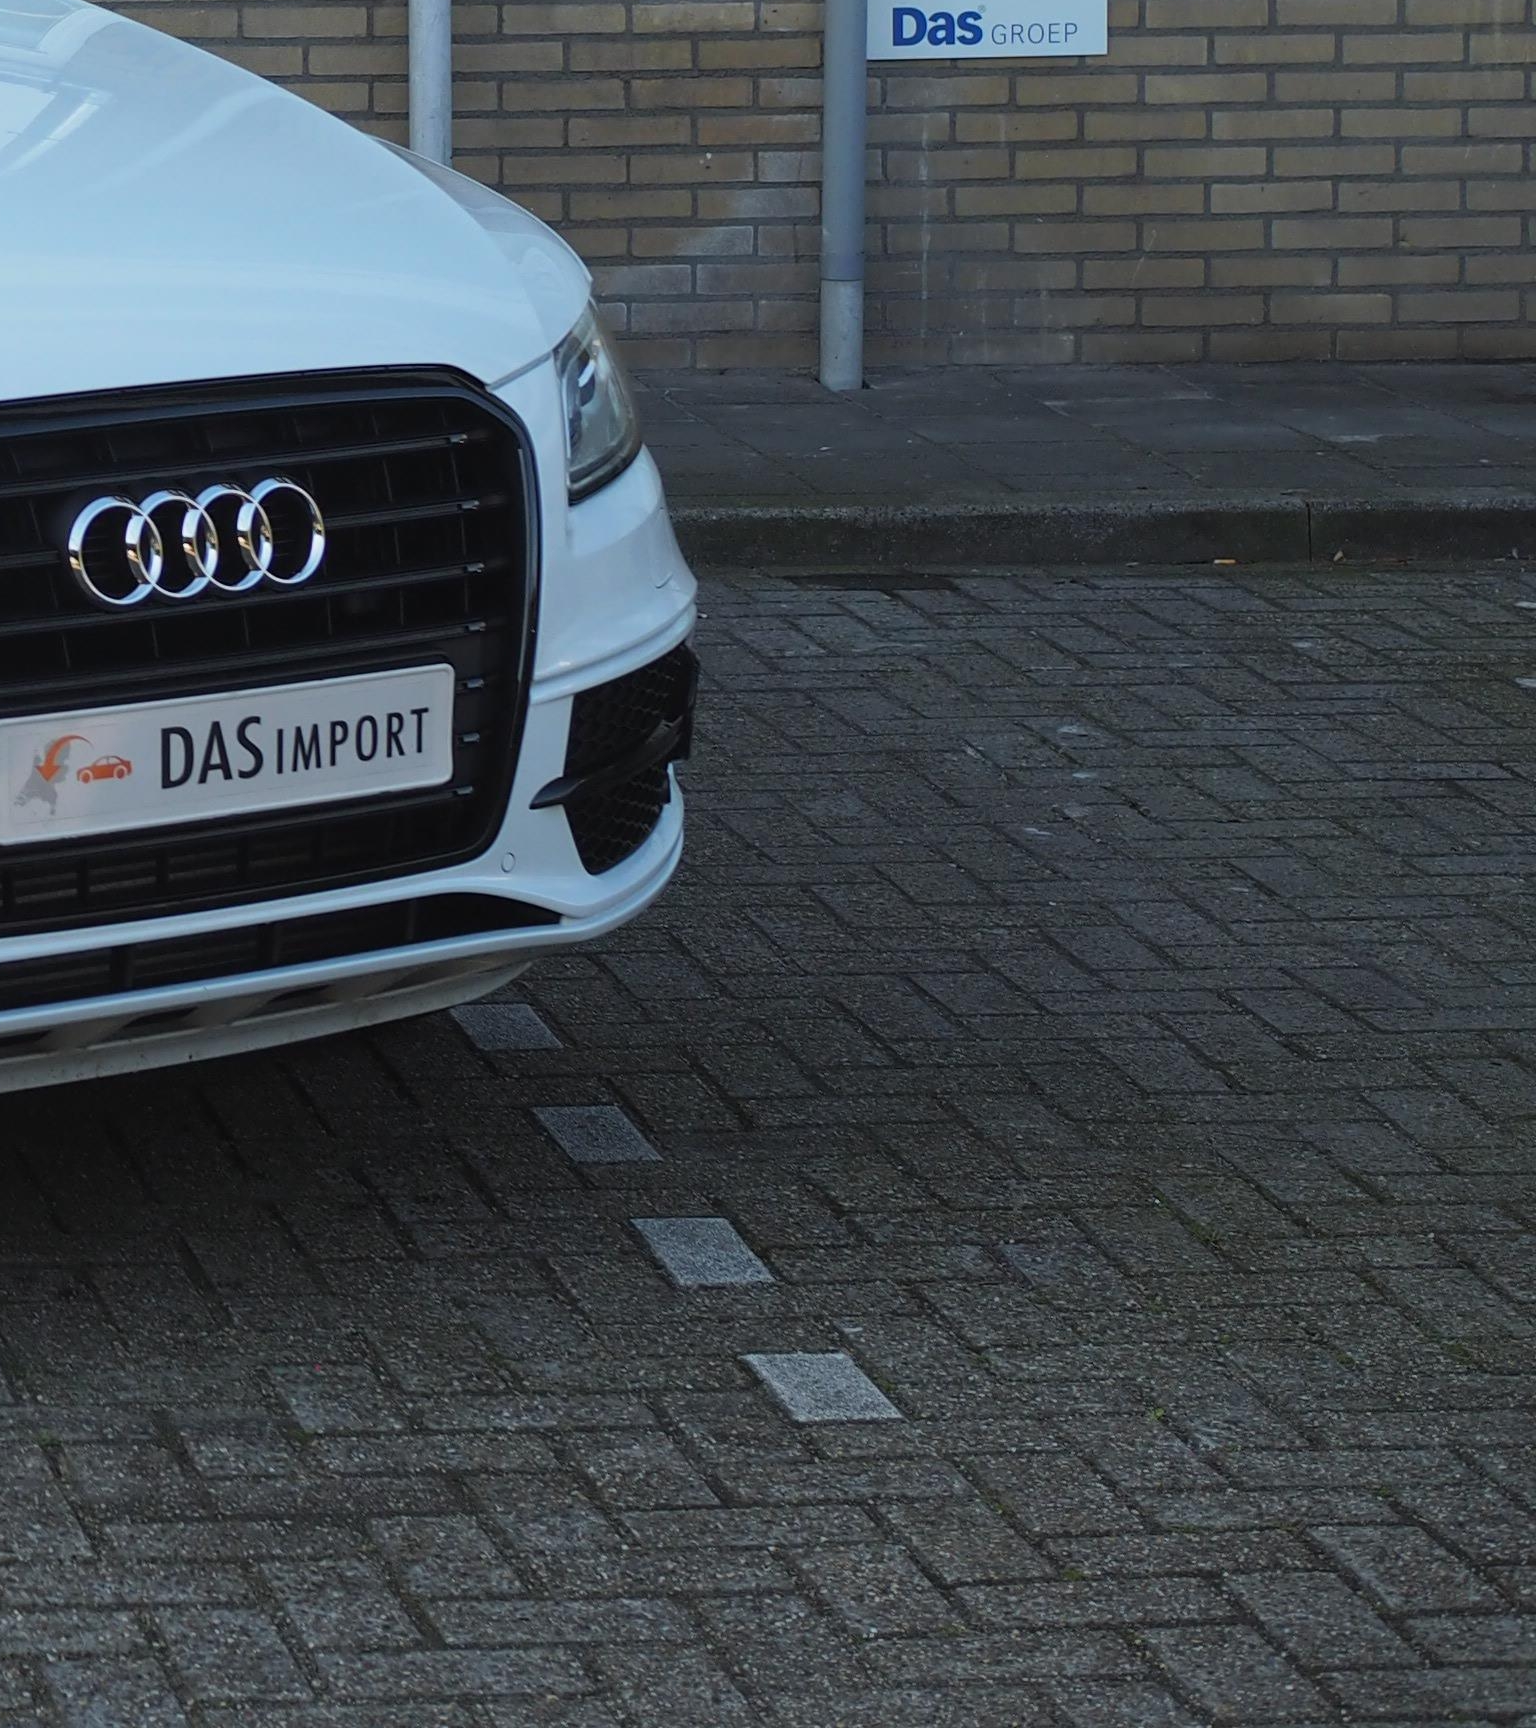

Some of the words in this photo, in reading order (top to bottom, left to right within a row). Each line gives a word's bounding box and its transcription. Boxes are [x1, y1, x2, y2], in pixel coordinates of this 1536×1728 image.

[991, 23, 1078, 45] GROEP
[160, 716, 264, 790] DAS
[276, 707, 430, 775] IMPORT
